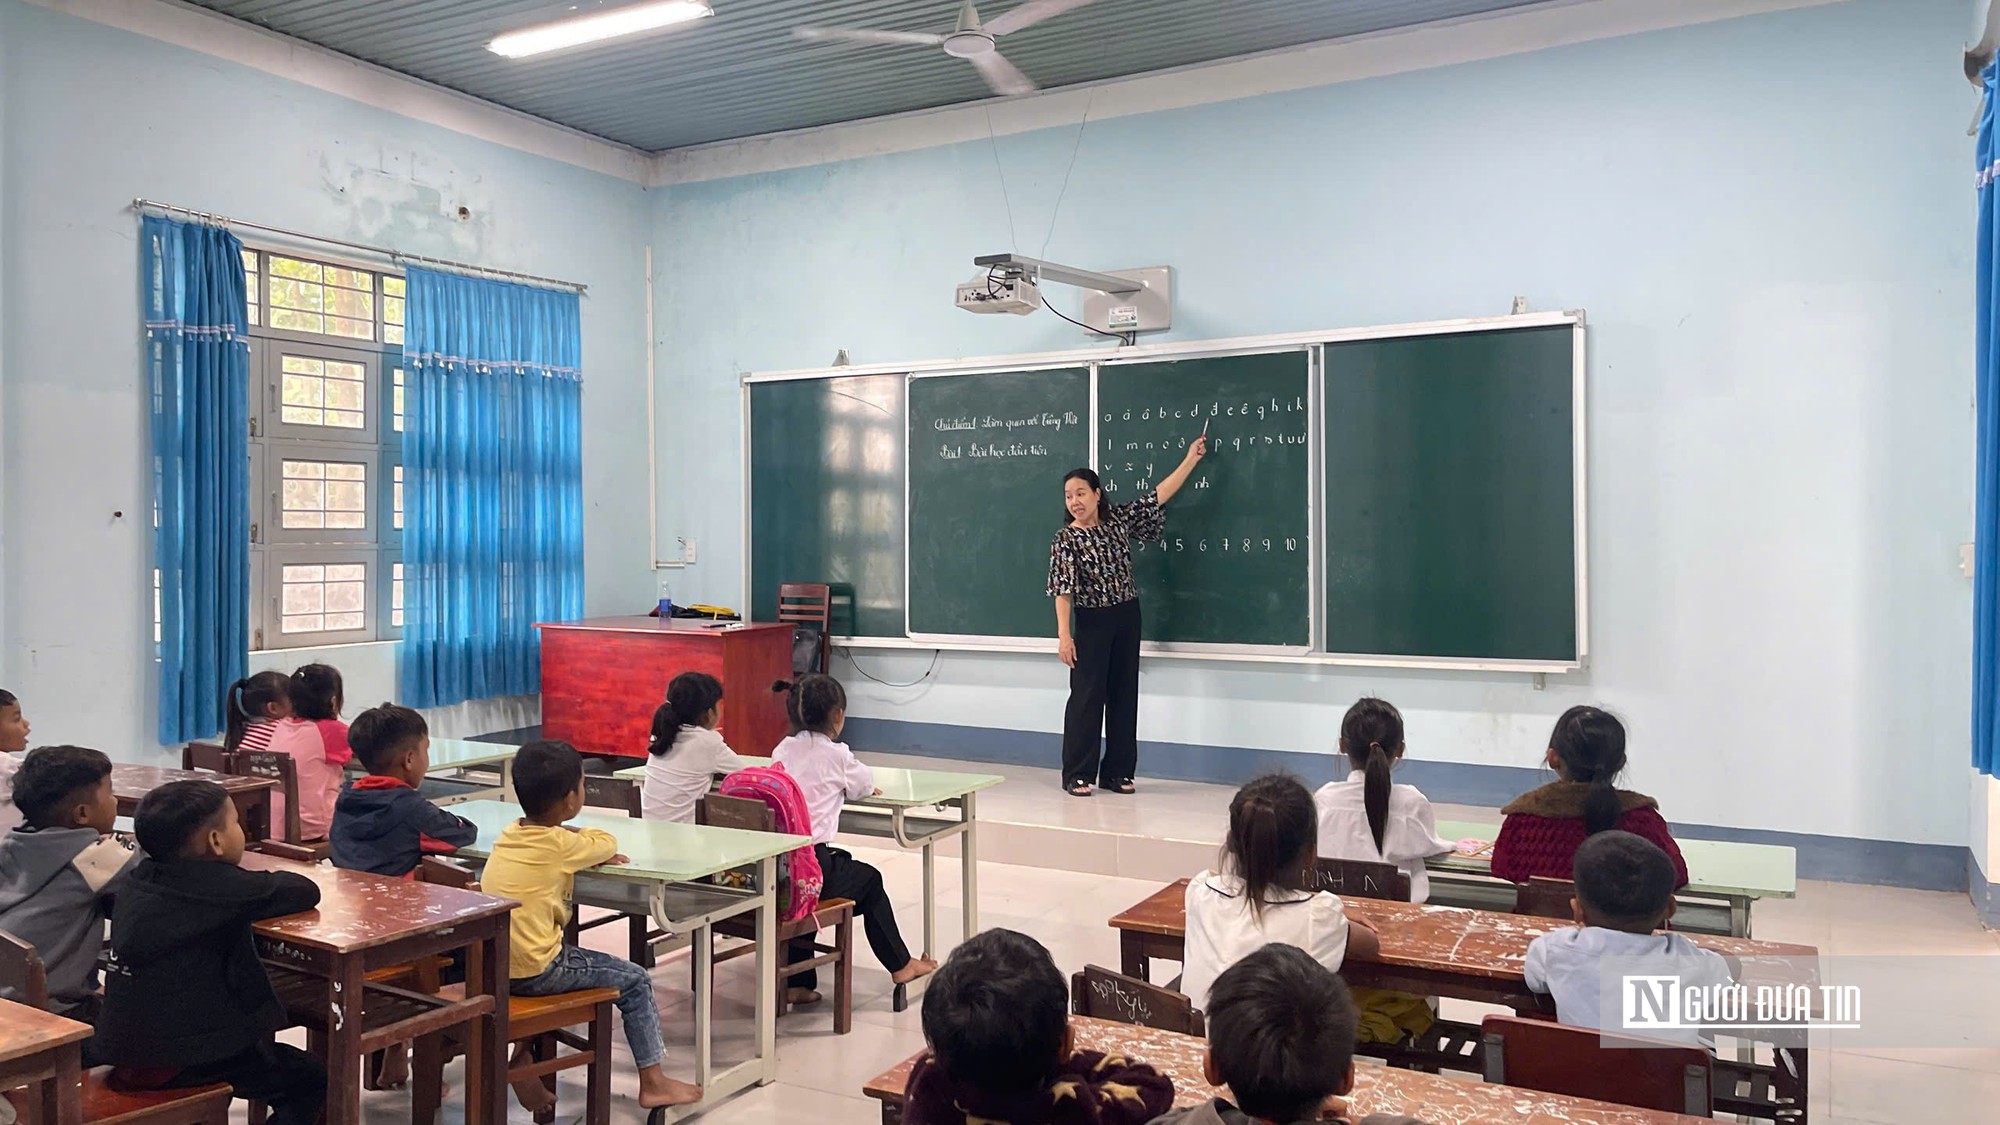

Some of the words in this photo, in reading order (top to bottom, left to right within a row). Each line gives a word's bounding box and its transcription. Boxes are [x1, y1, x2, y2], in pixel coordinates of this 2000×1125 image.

[1159, 406, 1167, 419] b
[1174, 410, 1182, 419] c
[1190, 403, 1199, 418] d
[1210, 401, 1218, 417] đ
[1240, 402, 1249, 415] ê
[1271, 397, 1279, 412] h
[1287, 401, 1292, 412] i
[1296, 396, 1303, 411] k
[1126, 442, 1139, 451] m
[1145, 441, 1154, 450] n
[1162, 440, 1170, 450] o
[1214, 438, 1223, 453] p
[1232, 437, 1241, 452] q
[1249, 436, 1256, 445] r
[1278, 433, 1284, 445] t
[1103, 463, 1114, 472] v
[1145, 462, 1153, 479] y
[1104, 478, 1118, 493] ch
[1135, 477, 1150, 491] th
[1194, 476, 1210, 490] nh
[1158, 537, 1168, 552] 4
[1175, 538, 1184, 552] 5
[1199, 538, 1207, 552] 6
[1223, 537, 1230, 551] 7
[1242, 538, 1251, 553] 8
[1262, 538, 1271, 552] 9
[1284, 537, 1298, 552] 10
